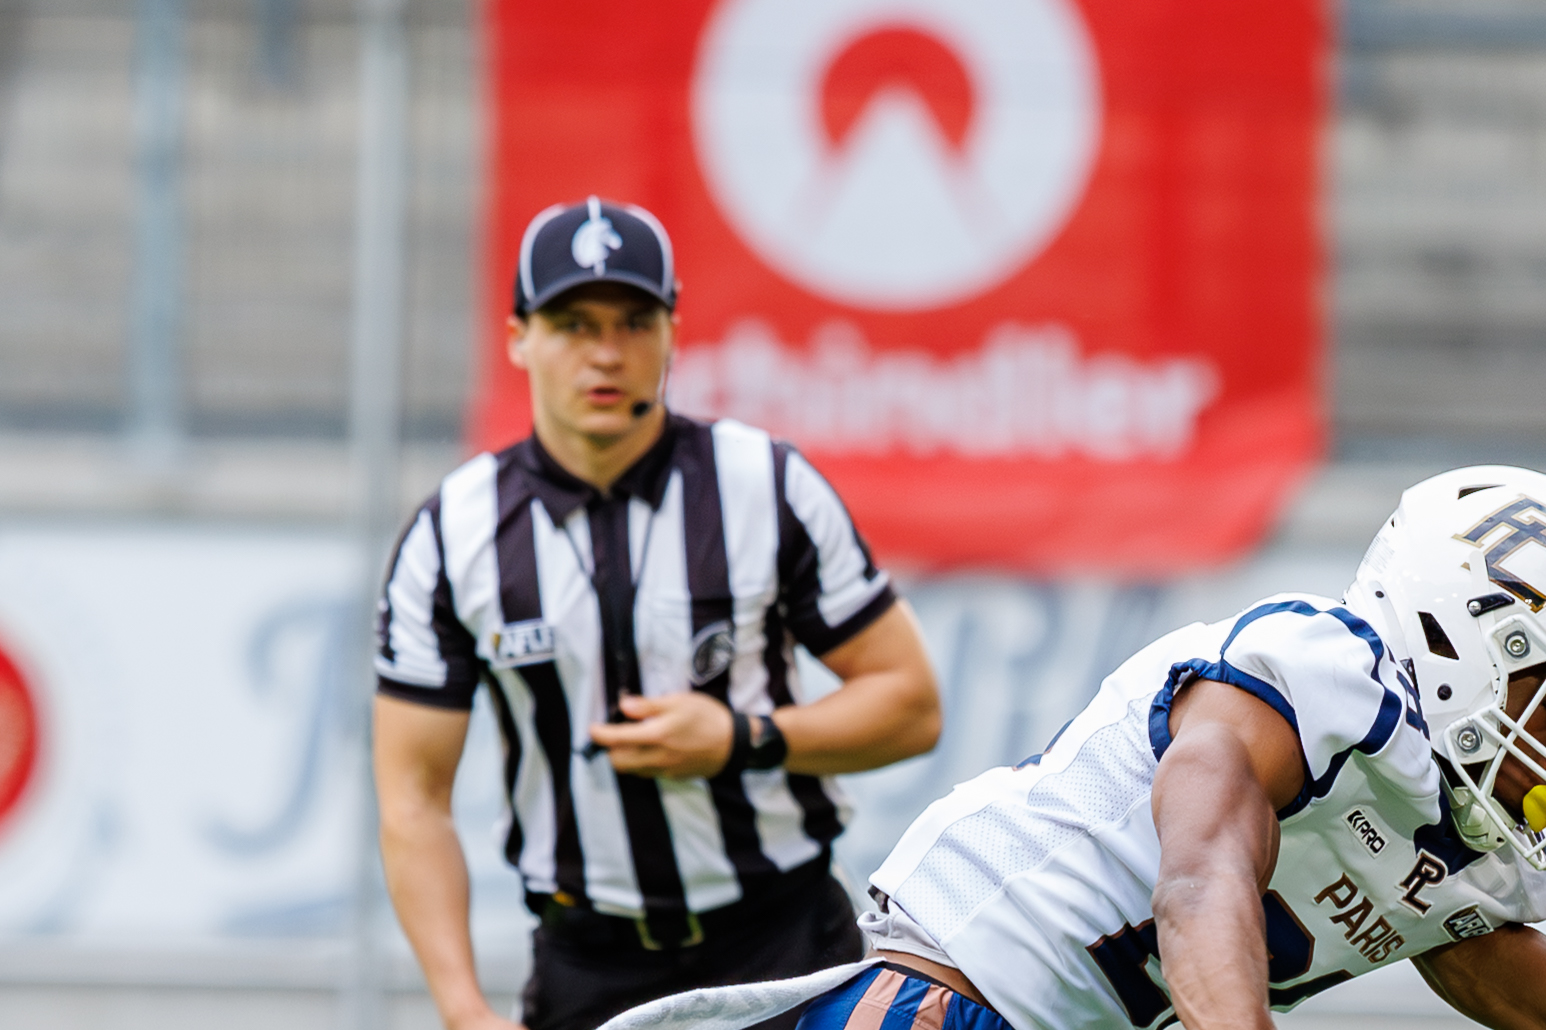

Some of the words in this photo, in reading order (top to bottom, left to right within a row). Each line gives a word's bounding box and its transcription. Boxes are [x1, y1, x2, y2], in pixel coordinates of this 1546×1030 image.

[668, 318, 1221, 460] chindler
[1346, 809, 1386, 854] KPRO
[1312, 872, 1407, 965] PARIS
